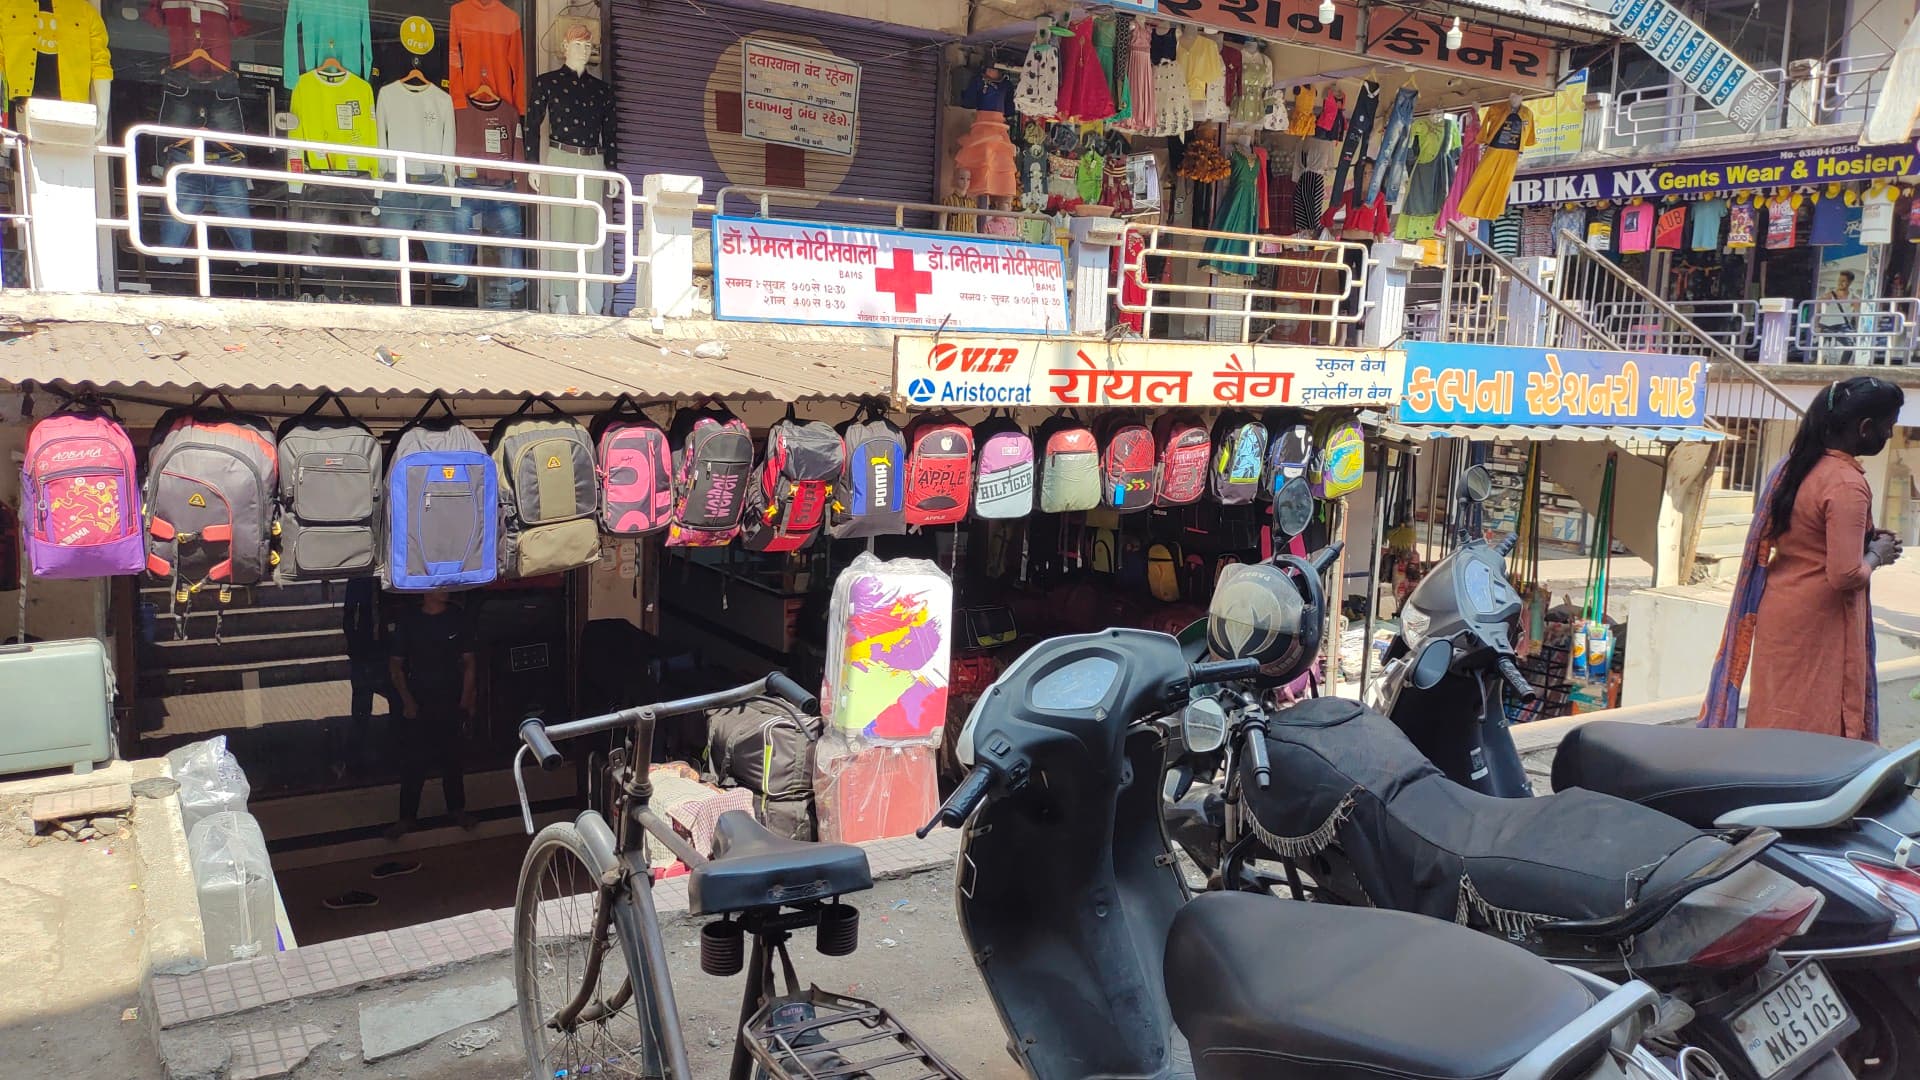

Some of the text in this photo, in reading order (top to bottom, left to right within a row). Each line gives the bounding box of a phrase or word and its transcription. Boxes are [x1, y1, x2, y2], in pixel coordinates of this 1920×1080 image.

[1674, 36, 1702, 71] D.C.A
[825, 65, 853, 86] रहेगा
[1716, 67, 1745, 105] A.D.C.A
[747, 100, 793, 120] દવાખાનું
[798, 105, 817, 120] બંધ
[1730, 79, 1765, 121] SPOKEN
[1738, 88, 1775, 130] ENGLISH
[1509, 173, 1600, 204] BIKA
[1612, 168, 1658, 197] NX
[1658, 153, 1914, 191] Gents Wear & Hosiery
[748, 226, 793, 259] प्रेमल
[796, 231, 878, 265] नोटीसवाला
[839, 270, 863, 280] BAMS
[949, 246, 999, 275] निलिमा
[1001, 248, 1064, 280] नोटीसवाला
[1035, 283, 1056, 292] BAMS
[961, 347, 1019, 372] VIP
[1049, 349, 1295, 403] रोयल बैग
[1360, 354, 1386, 374] बैग
[941, 380, 1032, 403] Aristocrat
[1367, 381, 1392, 401] बैग
[1408, 354, 1701, 418] કલ્પના સ્ટેશનરી માર્ટ
[918, 470, 966, 486] APPLE
[979, 475, 1032, 499] HILFIGER
[1762, 976, 1813, 1026] GJ05
[1765, 994, 1841, 1064] NK5105
